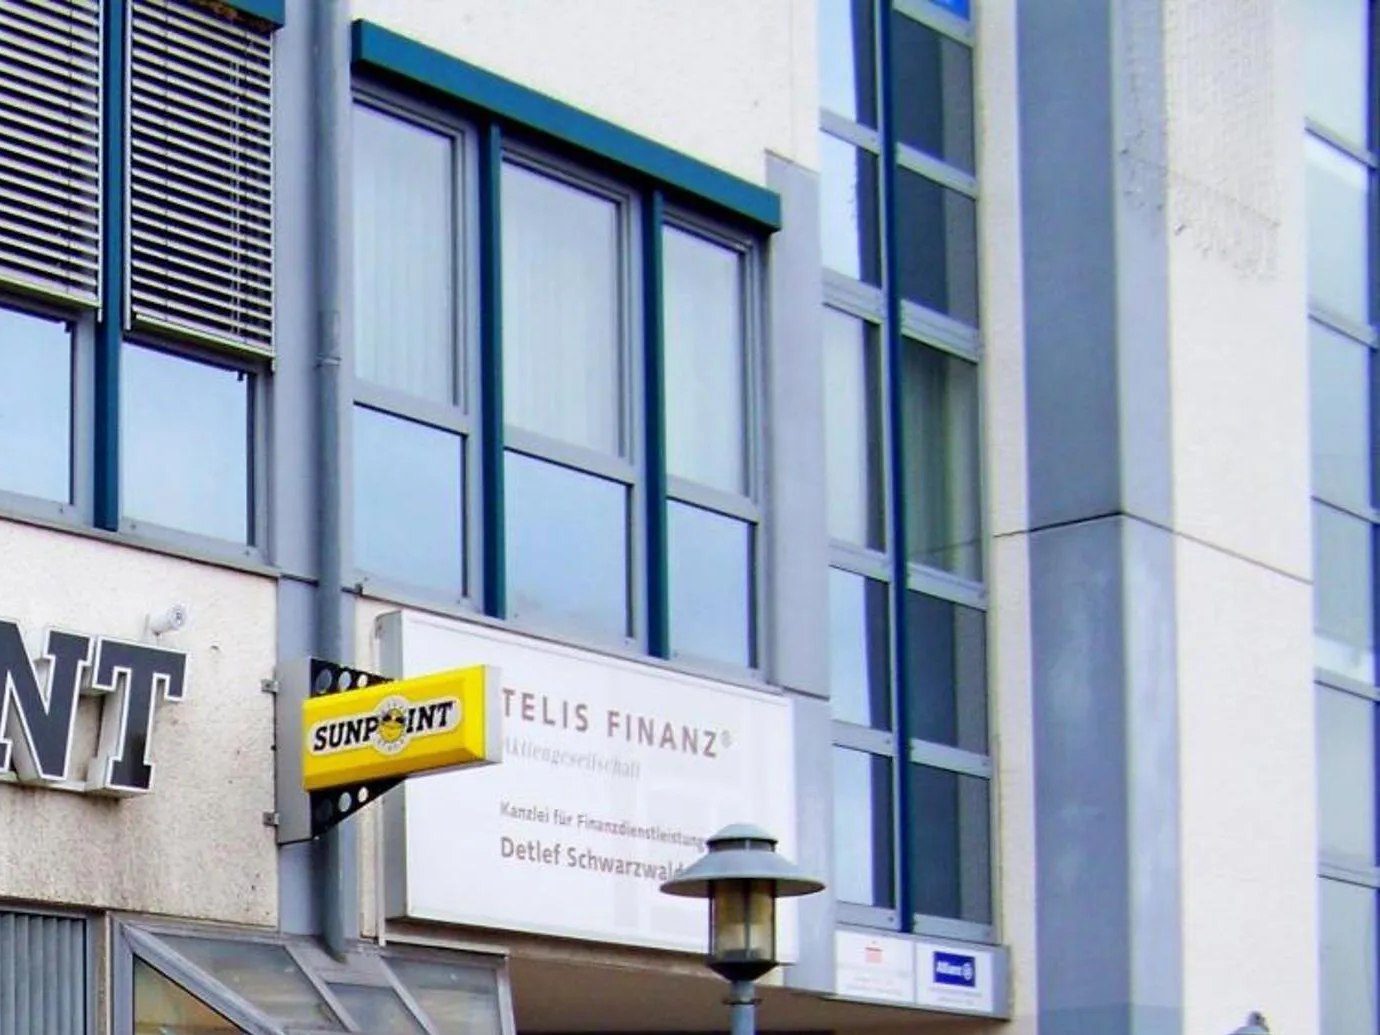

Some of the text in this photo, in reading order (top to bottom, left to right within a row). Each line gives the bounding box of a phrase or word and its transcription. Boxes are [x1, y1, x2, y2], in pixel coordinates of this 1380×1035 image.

[502, 686, 590, 733] TELIS
[500, 800, 550, 824] Kanzlei
[553, 808, 572, 827] für
[500, 835, 562, 866] Detlef
